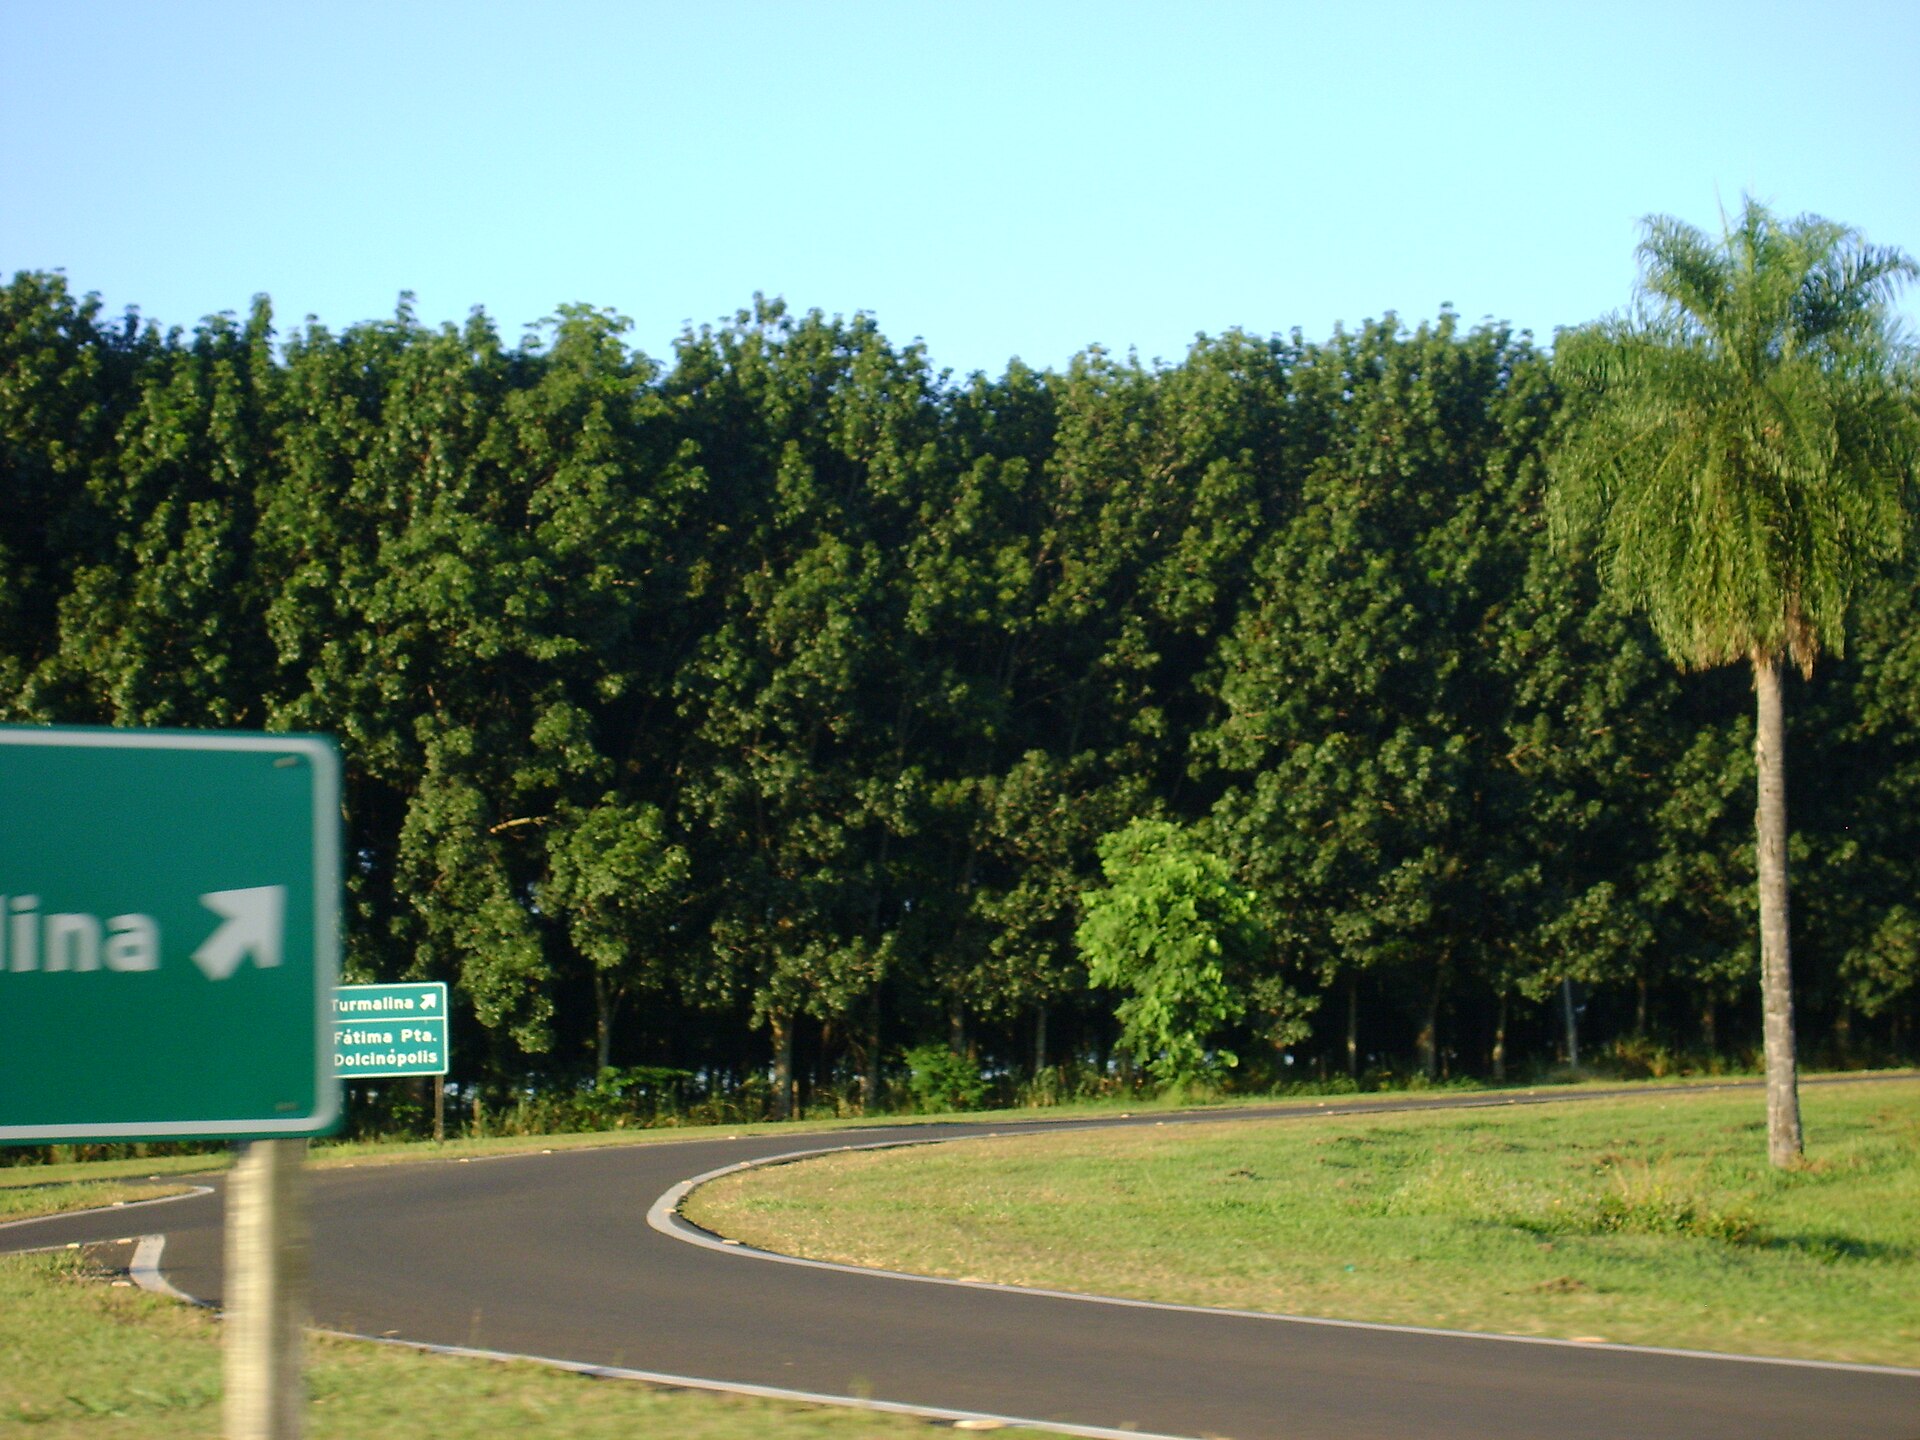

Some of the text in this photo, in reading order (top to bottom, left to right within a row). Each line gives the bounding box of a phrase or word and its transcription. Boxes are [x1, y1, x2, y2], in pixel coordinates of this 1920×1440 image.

[0, 894, 160, 973] ina
[331, 996, 414, 1012] Turmalina
[334, 1029, 438, 1045] Fátima Pta.
[334, 1048, 438, 1067] Dolcinópolis
